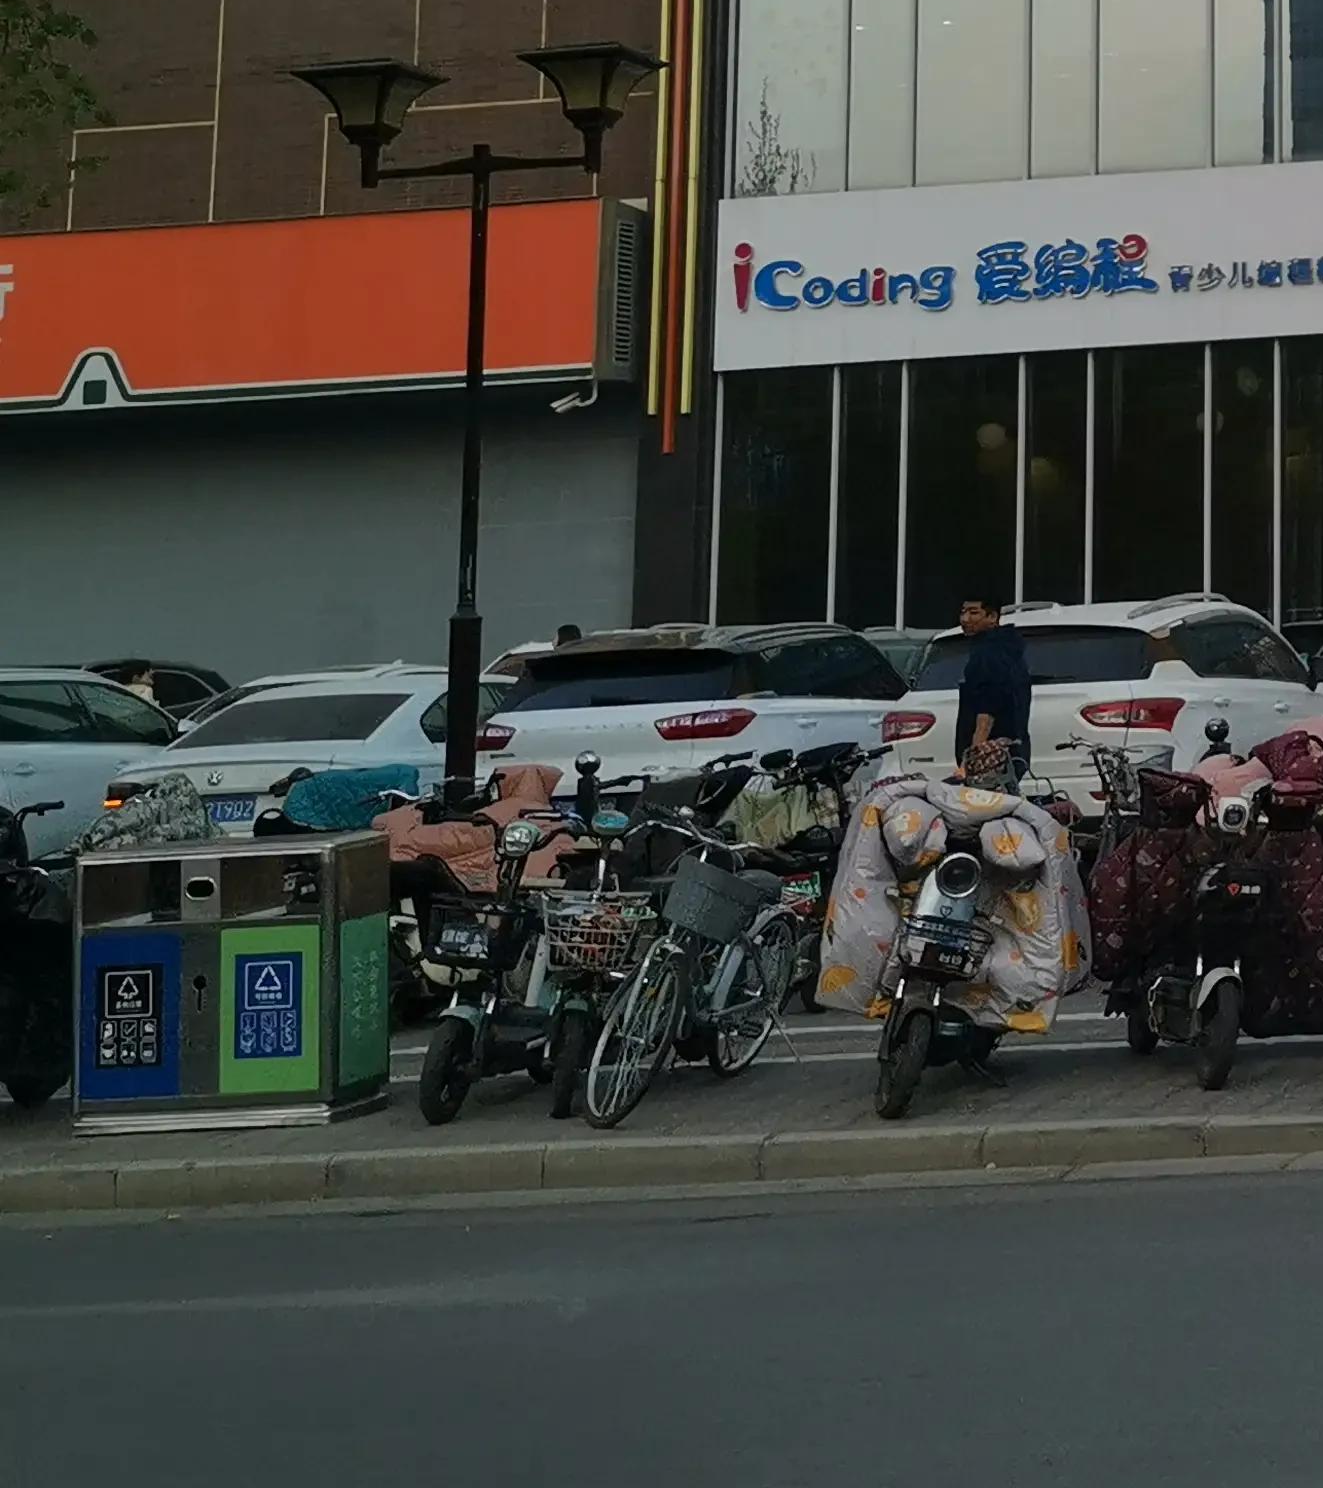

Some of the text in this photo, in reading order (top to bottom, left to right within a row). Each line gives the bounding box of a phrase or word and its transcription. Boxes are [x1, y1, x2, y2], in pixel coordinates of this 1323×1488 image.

[733, 242, 957, 312] iCoding
[974, 234, 1159, 305] 爱编程
